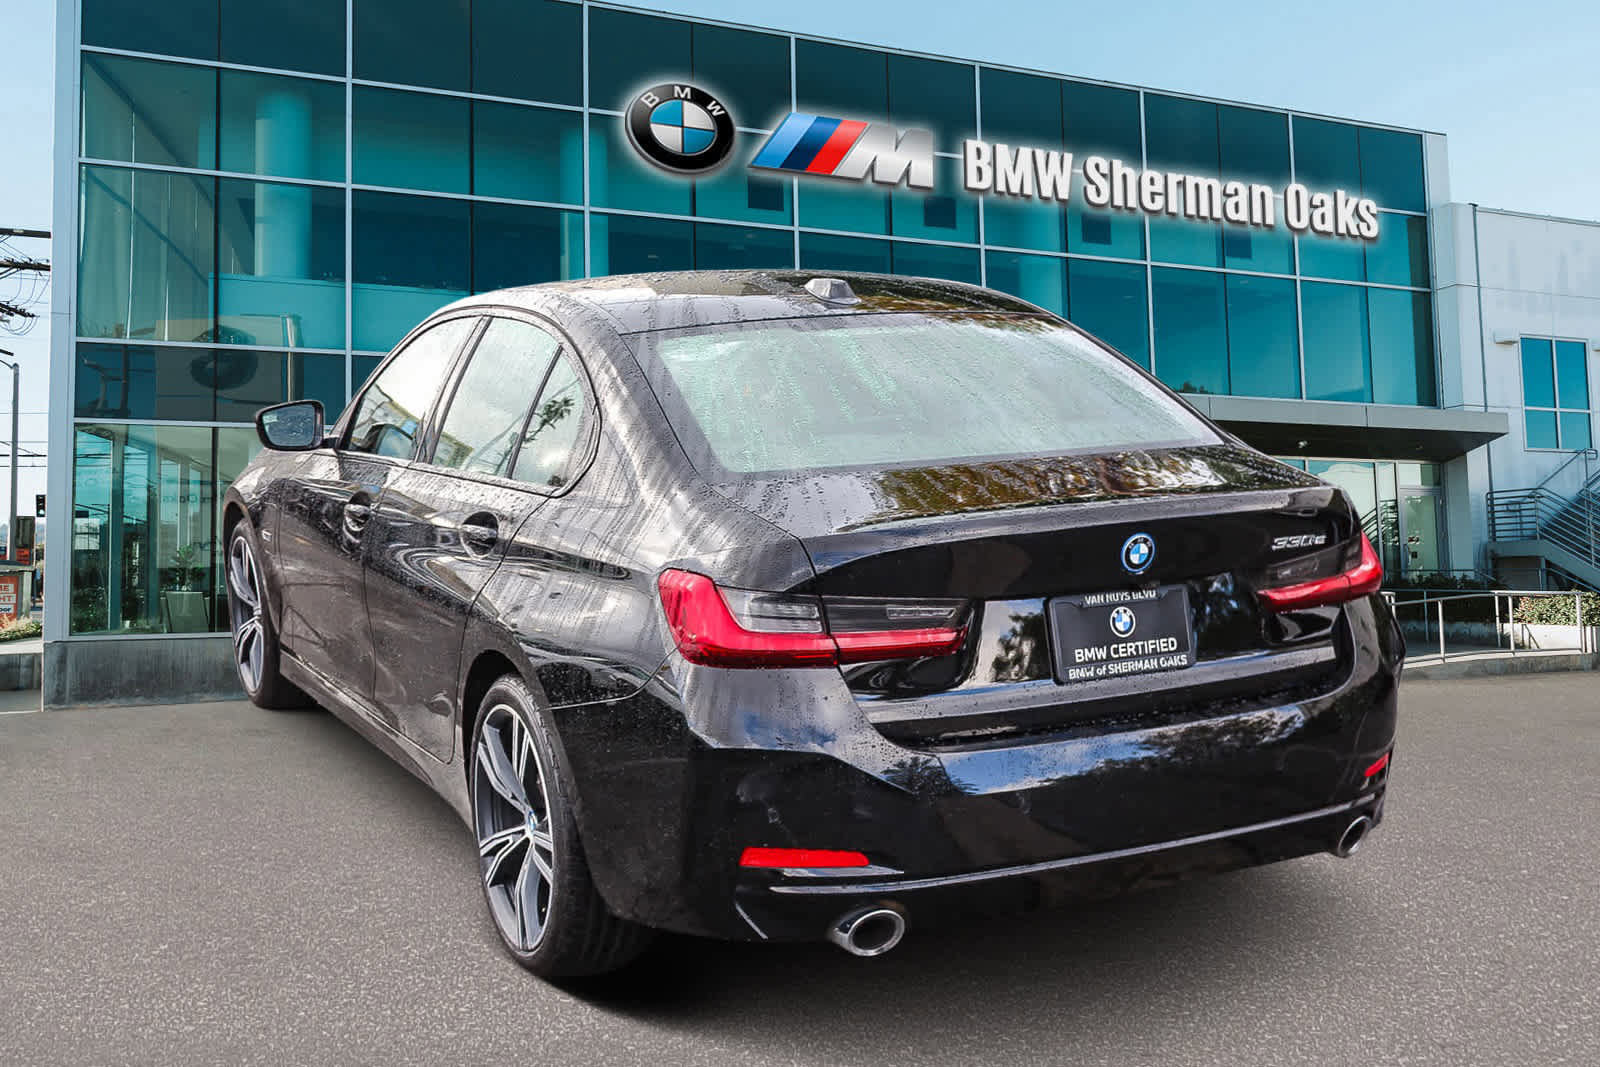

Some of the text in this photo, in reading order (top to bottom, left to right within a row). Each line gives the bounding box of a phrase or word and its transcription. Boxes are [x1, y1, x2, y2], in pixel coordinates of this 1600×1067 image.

[640, 84, 726, 117] BMW
[963, 138, 1379, 242] BMW Sherman Oaks
[1084, 589, 1157, 605] VAN NUYS BLVD
[1074, 637, 1178, 663] BMW CERTIFIED
[1068, 654, 1188, 680] BMW of SHERMAN OAKS
